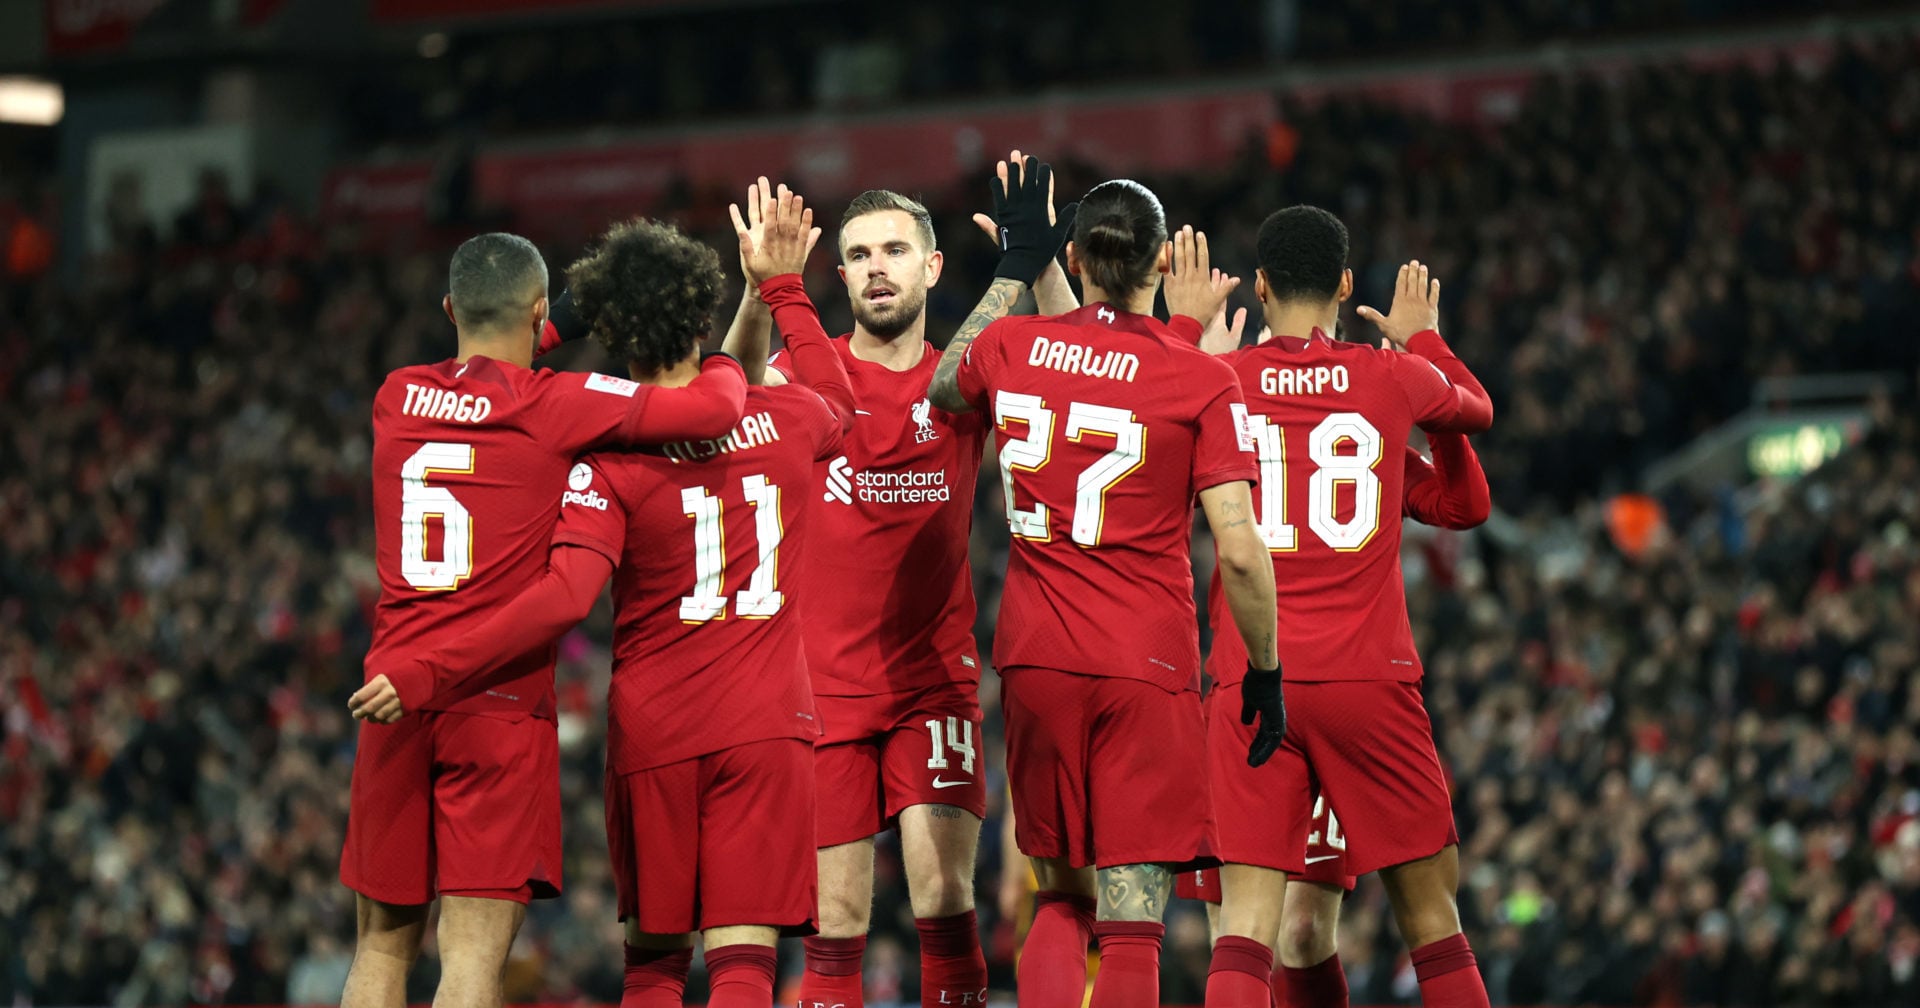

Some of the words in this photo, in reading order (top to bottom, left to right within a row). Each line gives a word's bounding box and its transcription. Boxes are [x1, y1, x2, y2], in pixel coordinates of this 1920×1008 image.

[1028, 336, 1139, 384] DARWIN
[1260, 365, 1349, 395] GAKPO
[402, 383, 491, 423] THIAGO
[855, 468, 945, 487] standard
[995, 389, 1148, 549] 27
[1248, 412, 1384, 553] 18
[401, 442, 475, 591] 6
[561, 490, 608, 511] pedia
[858, 485, 950, 503] chartered
[679, 474, 784, 624] 11
[926, 716, 975, 776] 14
